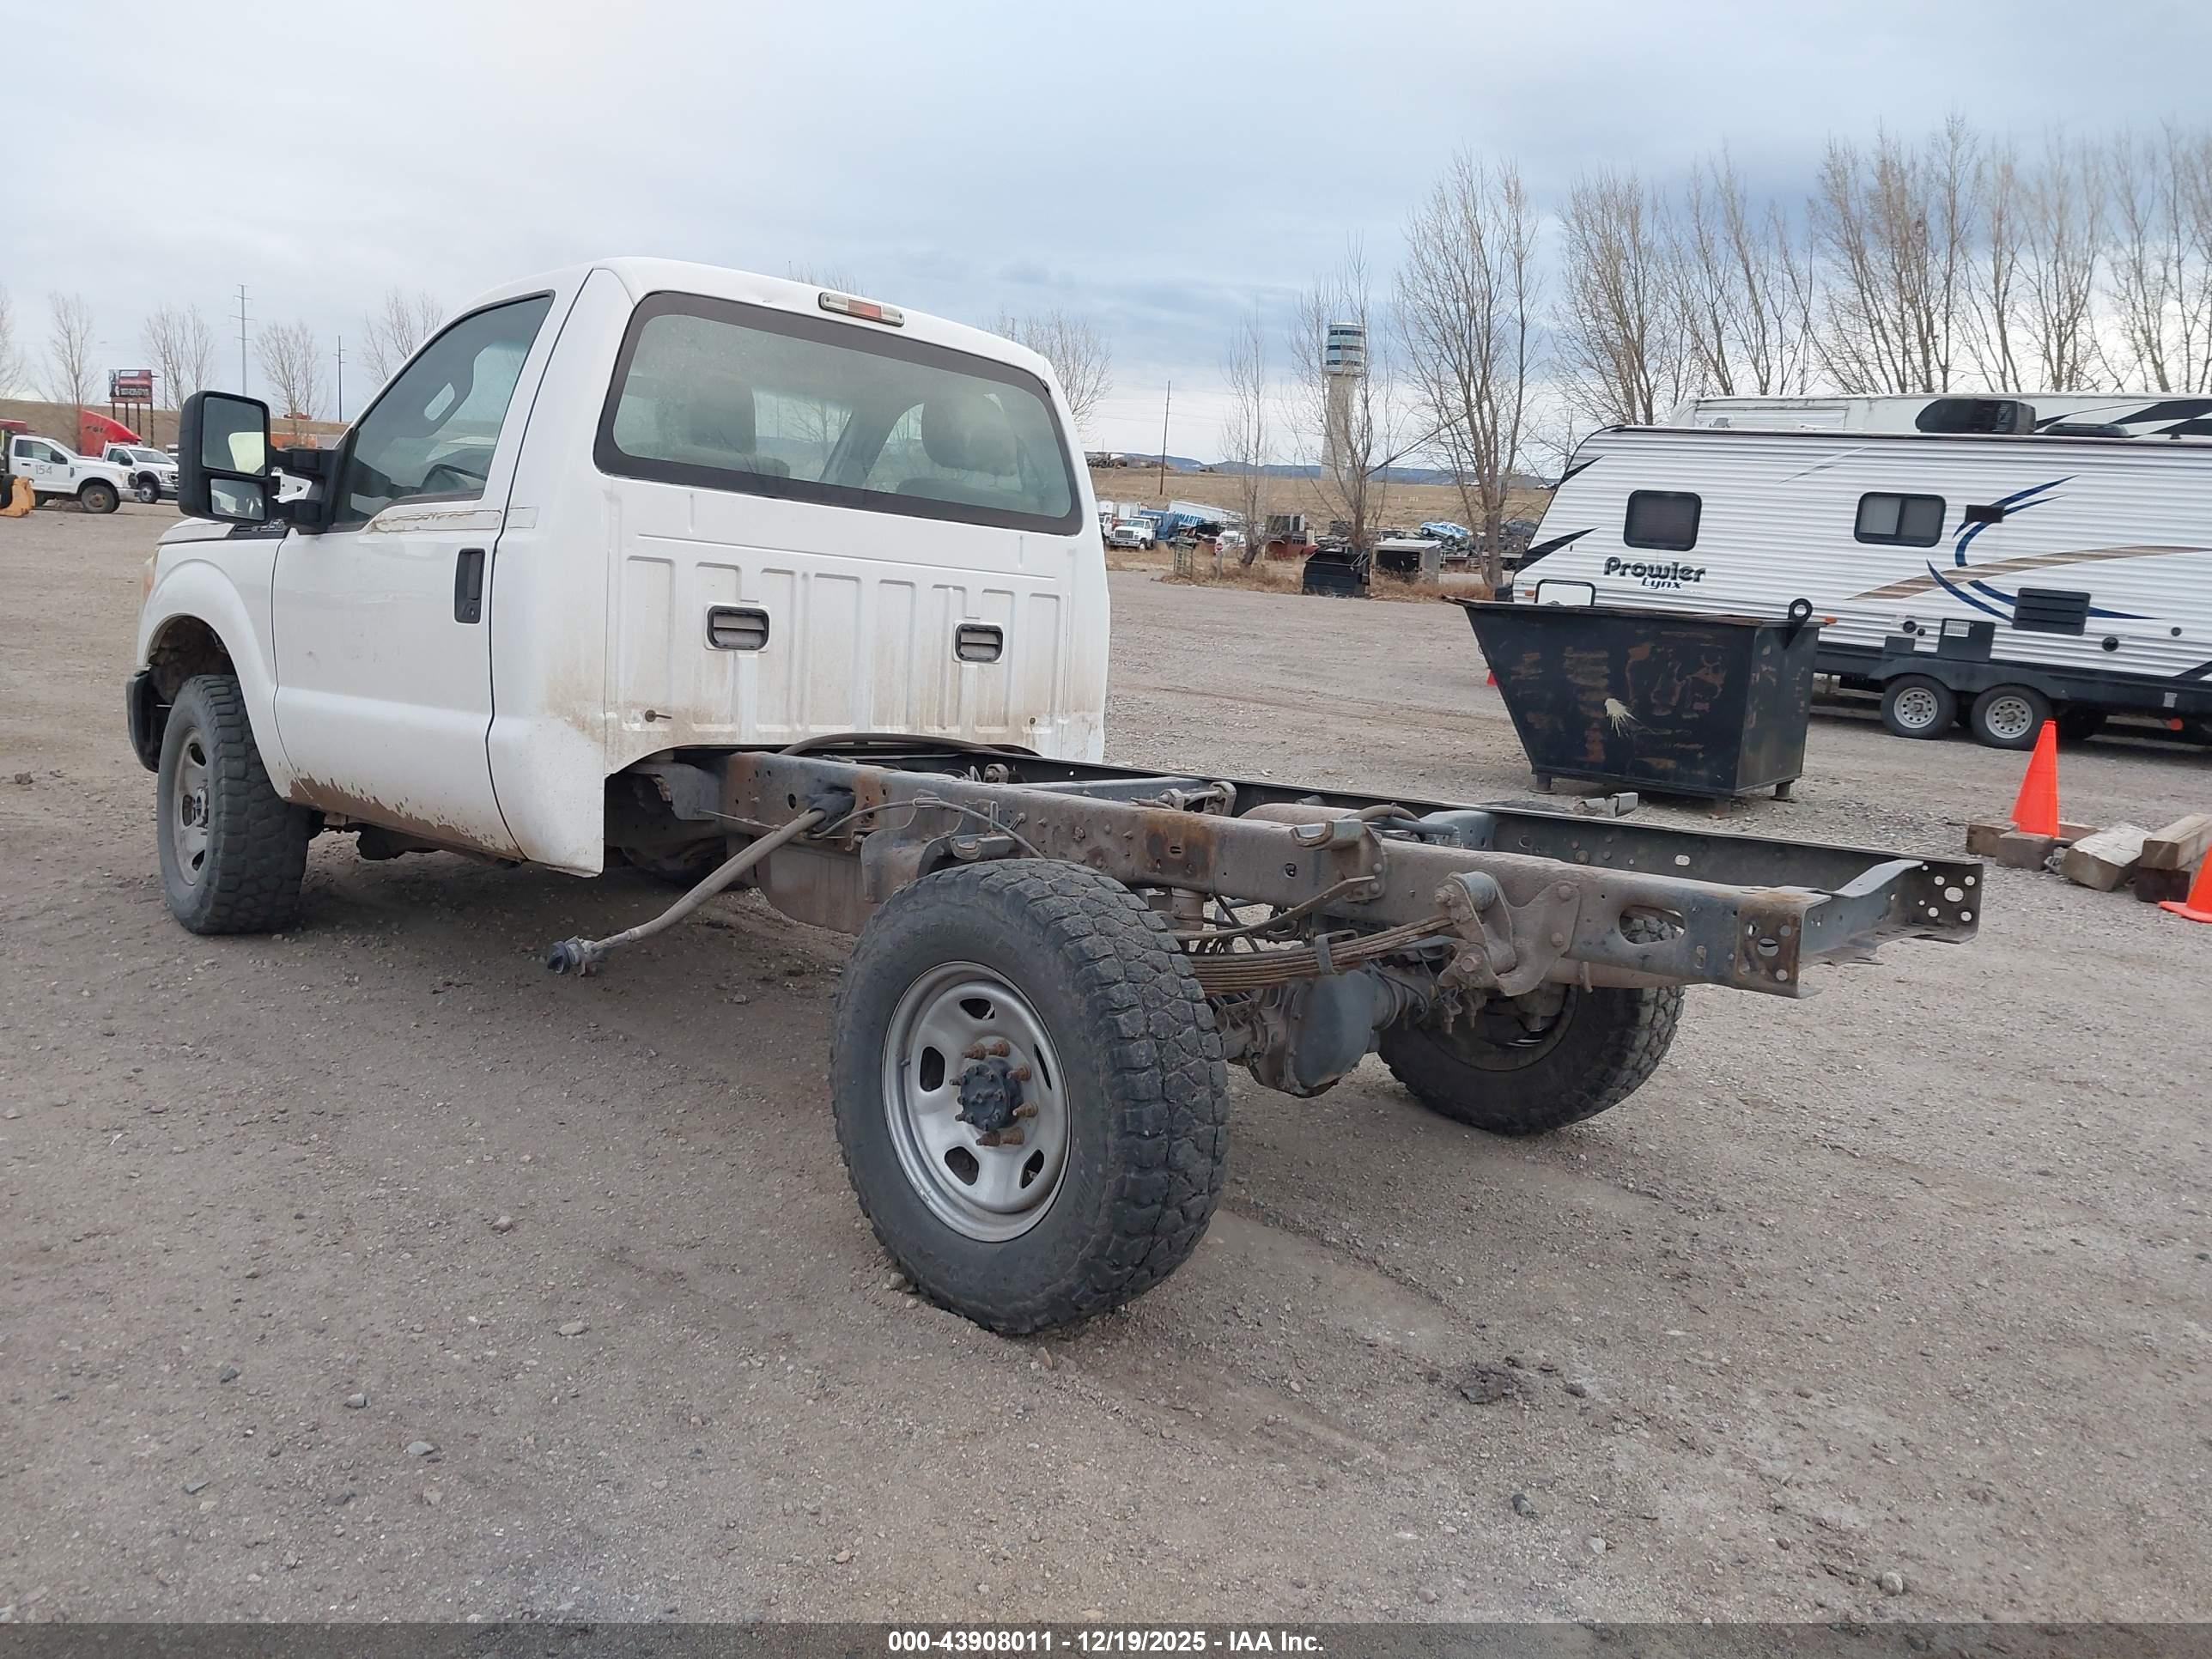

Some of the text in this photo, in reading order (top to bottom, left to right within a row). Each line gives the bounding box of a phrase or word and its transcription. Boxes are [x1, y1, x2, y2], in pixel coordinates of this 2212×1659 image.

[35, 465, 52, 475] 154
[1604, 556, 1706, 582] Prowler
[1641, 577, 1683, 590] Lynx
